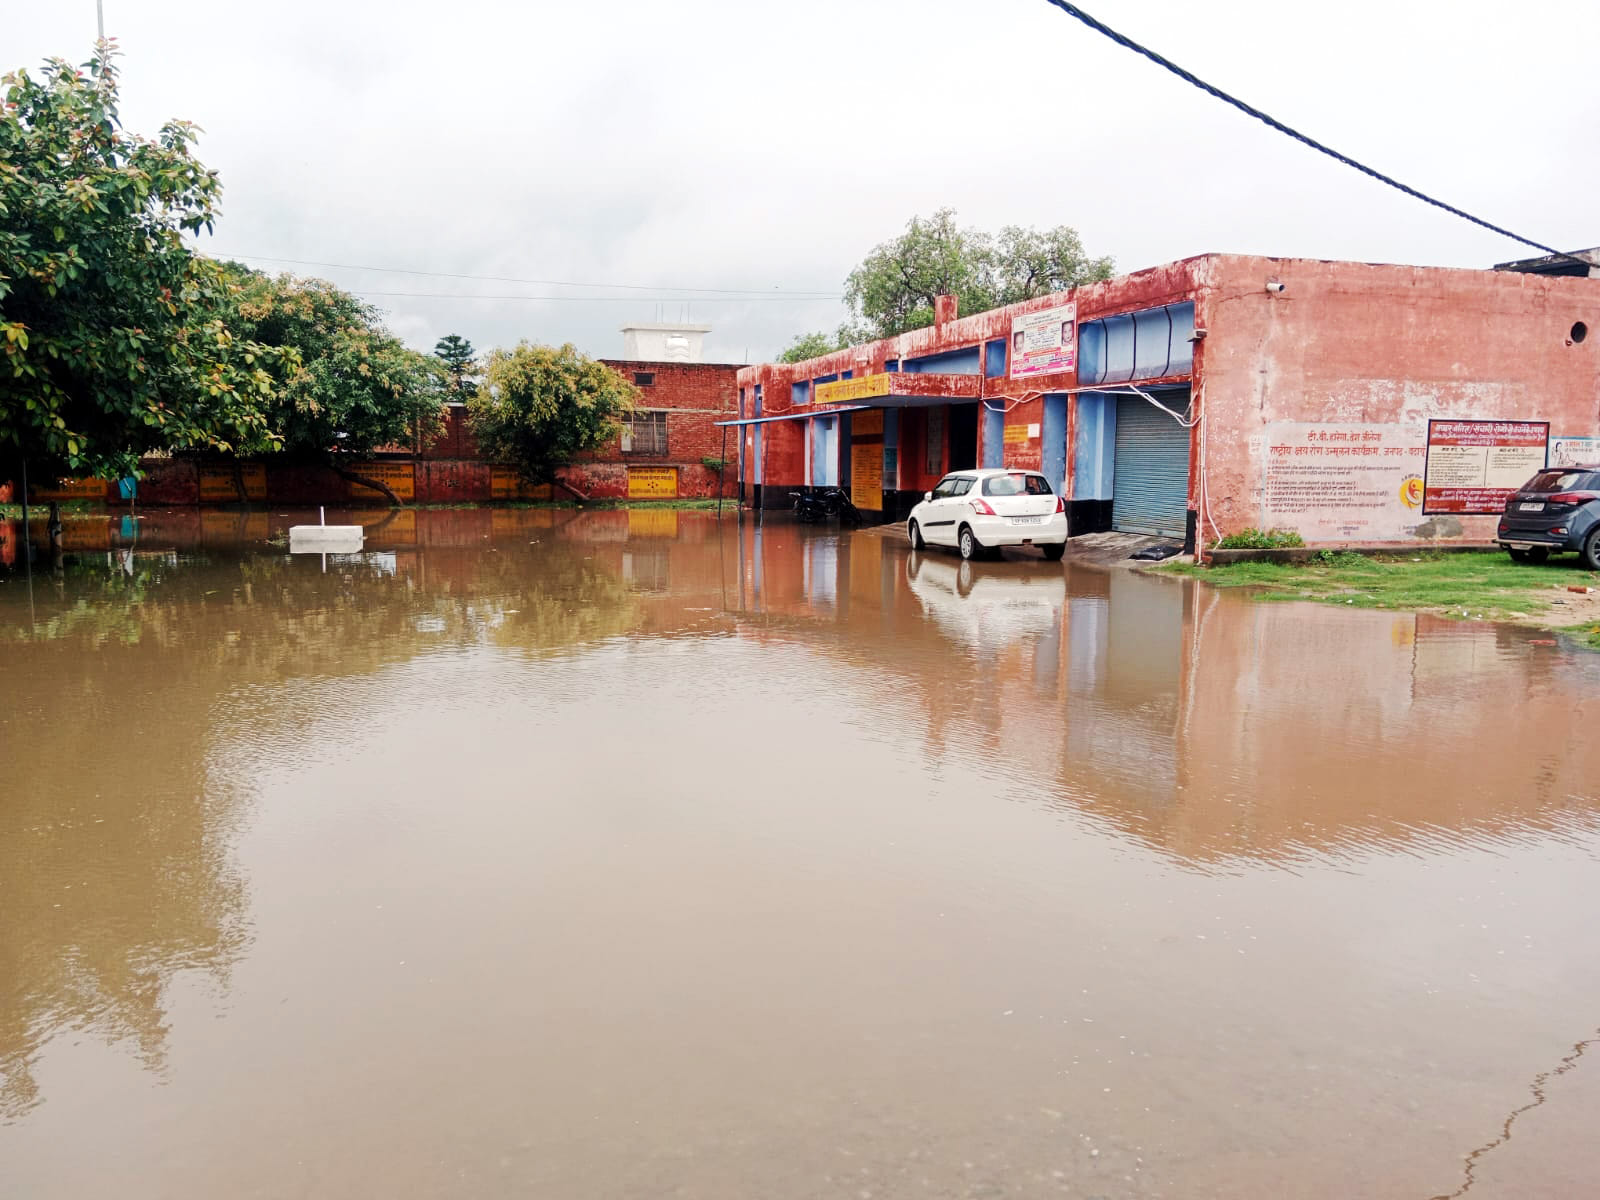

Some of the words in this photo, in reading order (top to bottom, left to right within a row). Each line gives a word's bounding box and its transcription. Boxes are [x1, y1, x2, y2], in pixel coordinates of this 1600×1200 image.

[1270, 443, 1292, 456] राष्ट्रीय
[1295, 446, 1309, 456] क्षय
[1310, 443, 1323, 456] रोग
